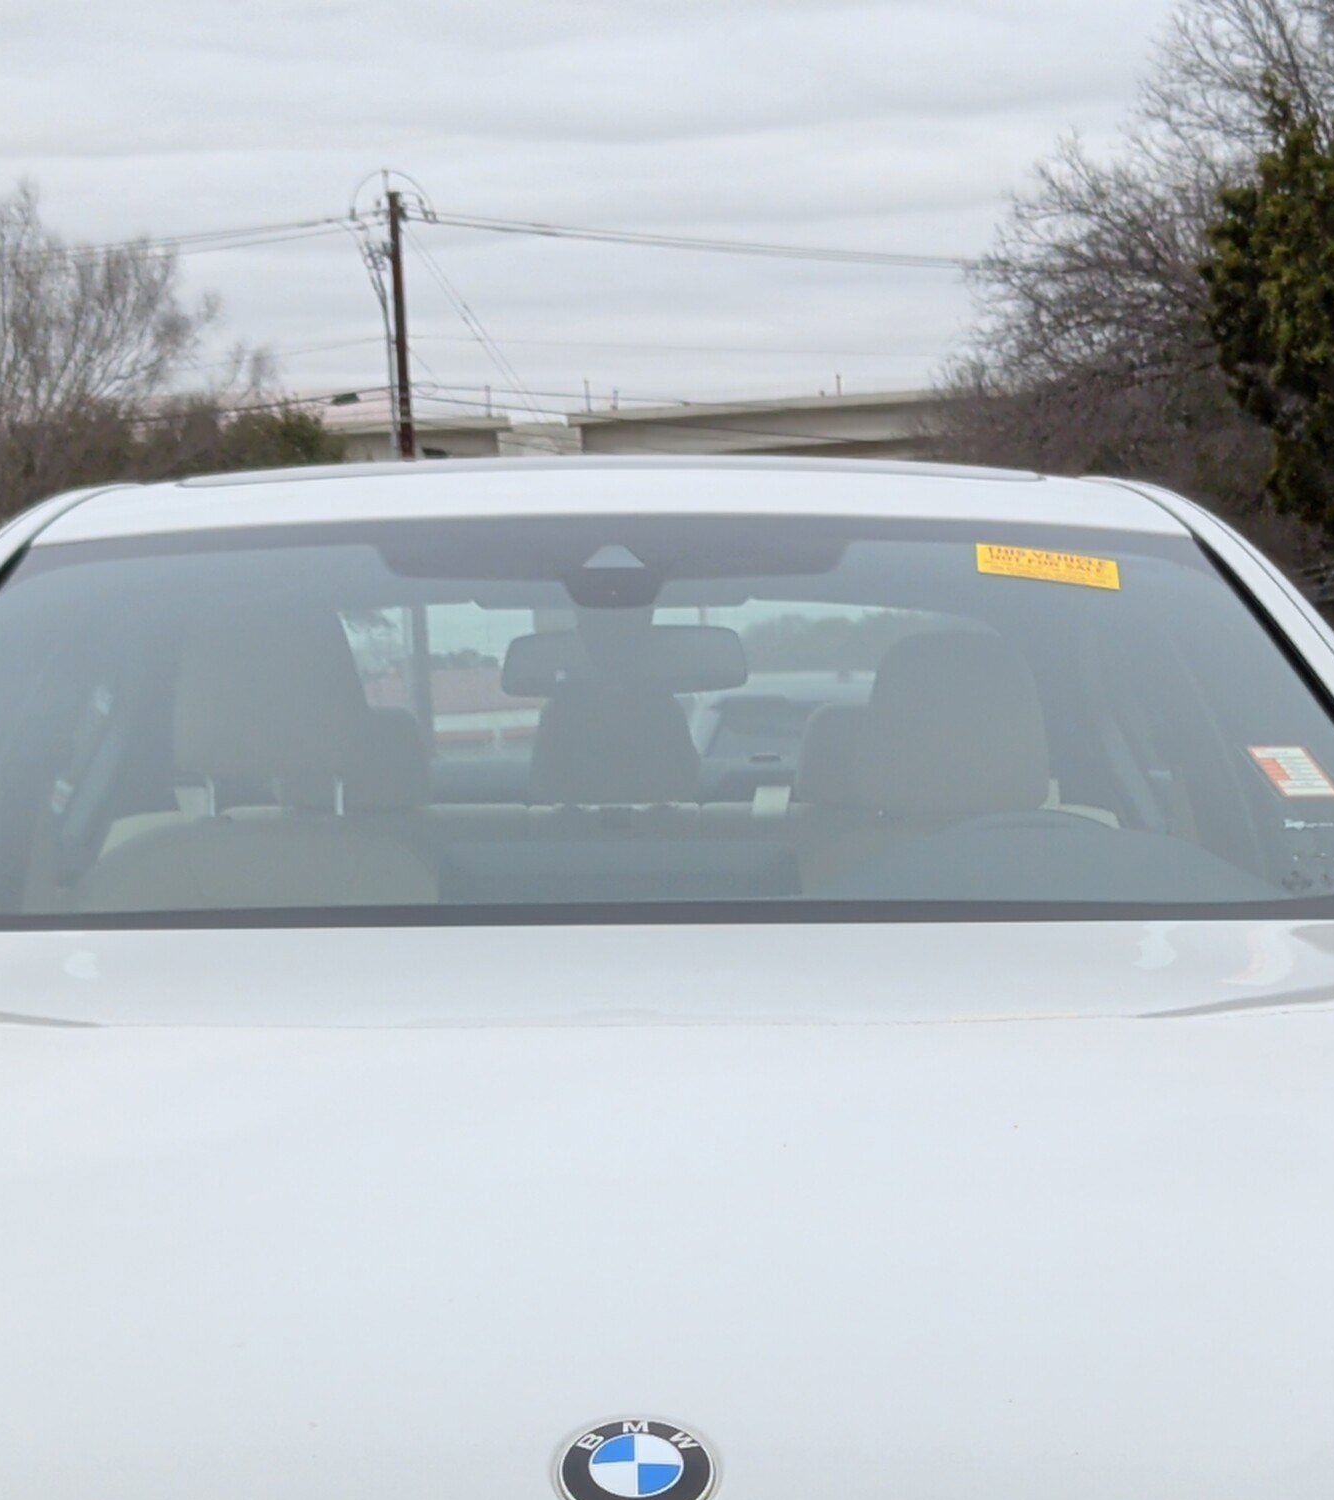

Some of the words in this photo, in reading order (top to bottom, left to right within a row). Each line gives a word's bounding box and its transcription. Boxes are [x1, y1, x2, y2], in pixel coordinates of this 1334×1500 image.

[988, 546, 1026, 558] THIS
[1032, 550, 1108, 568] VEHICLE
[990, 553, 1020, 563] NOT
[1027, 557, 1059, 568] FOR
[1066, 562, 1103, 574] SALE
[575, 1420, 700, 1450] BMW
